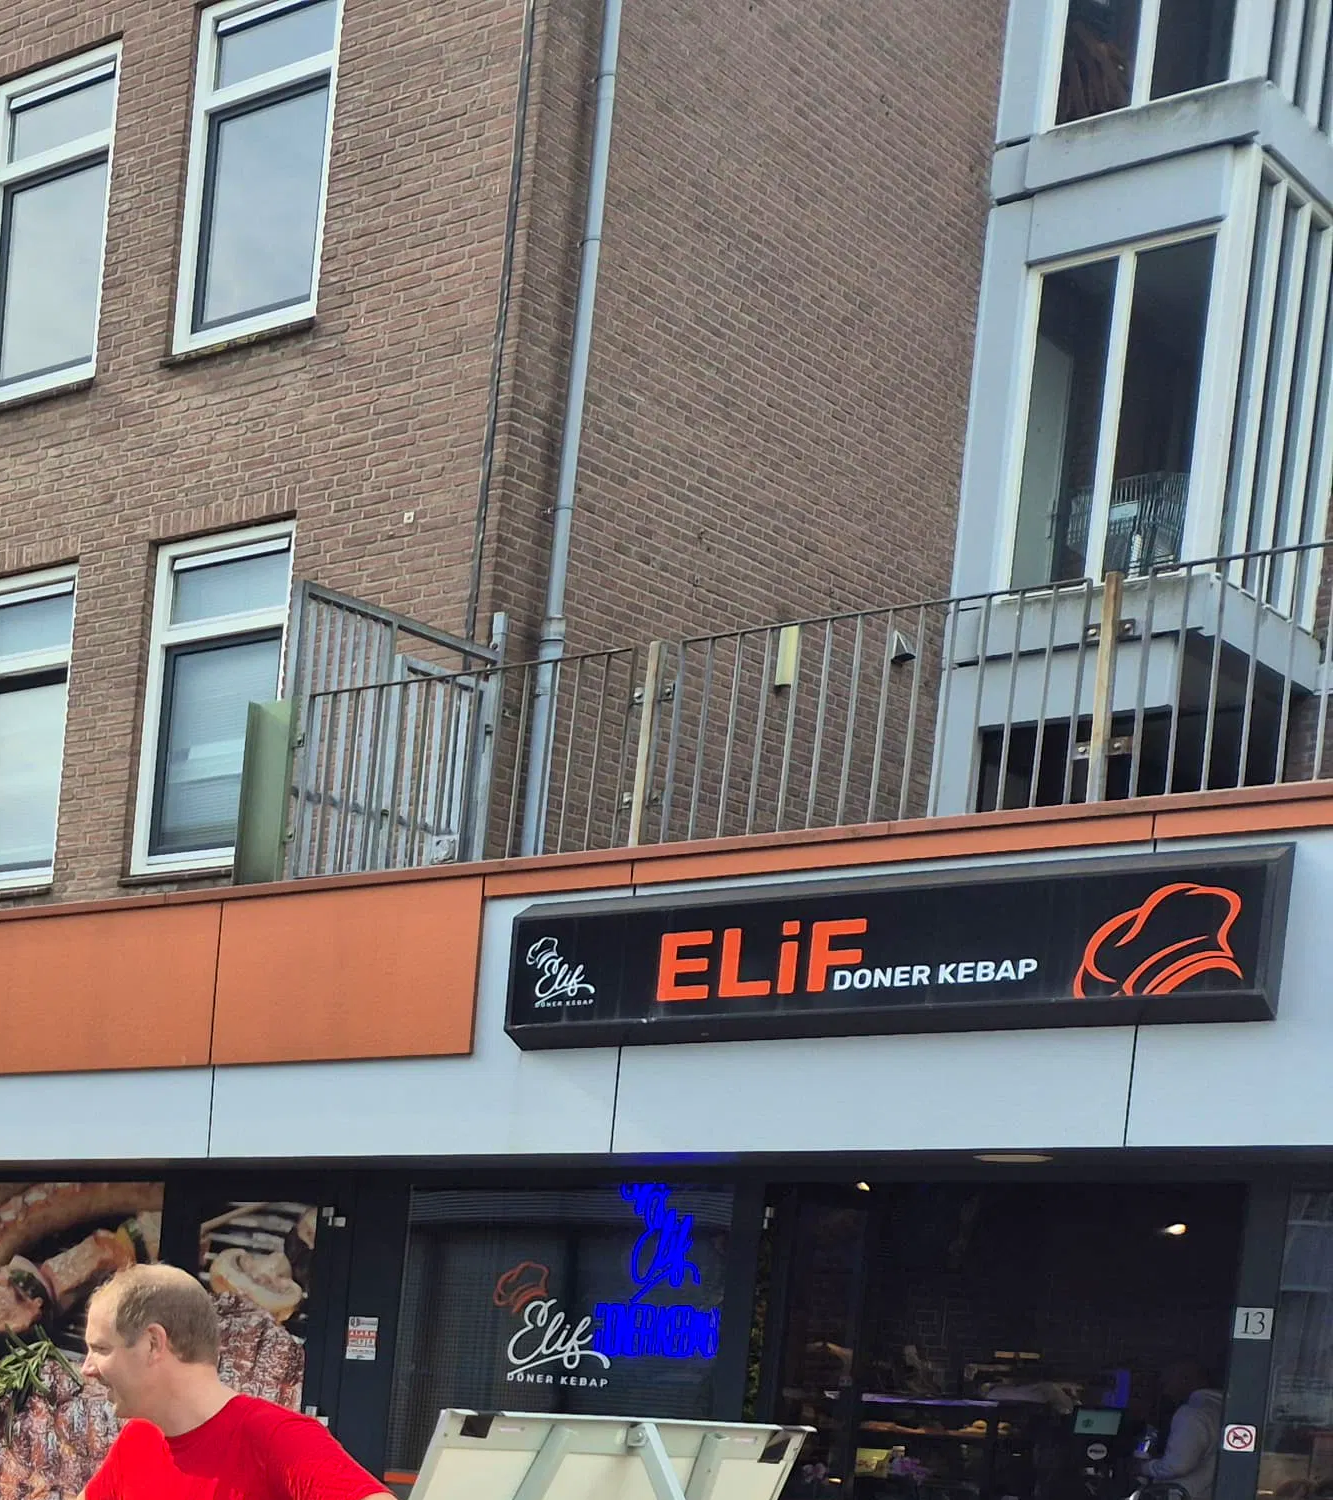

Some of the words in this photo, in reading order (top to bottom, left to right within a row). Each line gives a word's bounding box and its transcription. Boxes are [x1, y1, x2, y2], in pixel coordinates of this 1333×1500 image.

[833, 965, 930, 991] DONER
[937, 958, 1038, 985] KEBAP
[507, 1298, 611, 1374] Elif
[1241, 1311, 1266, 1335] 13
[560, 1375, 609, 1389] KEBAP
